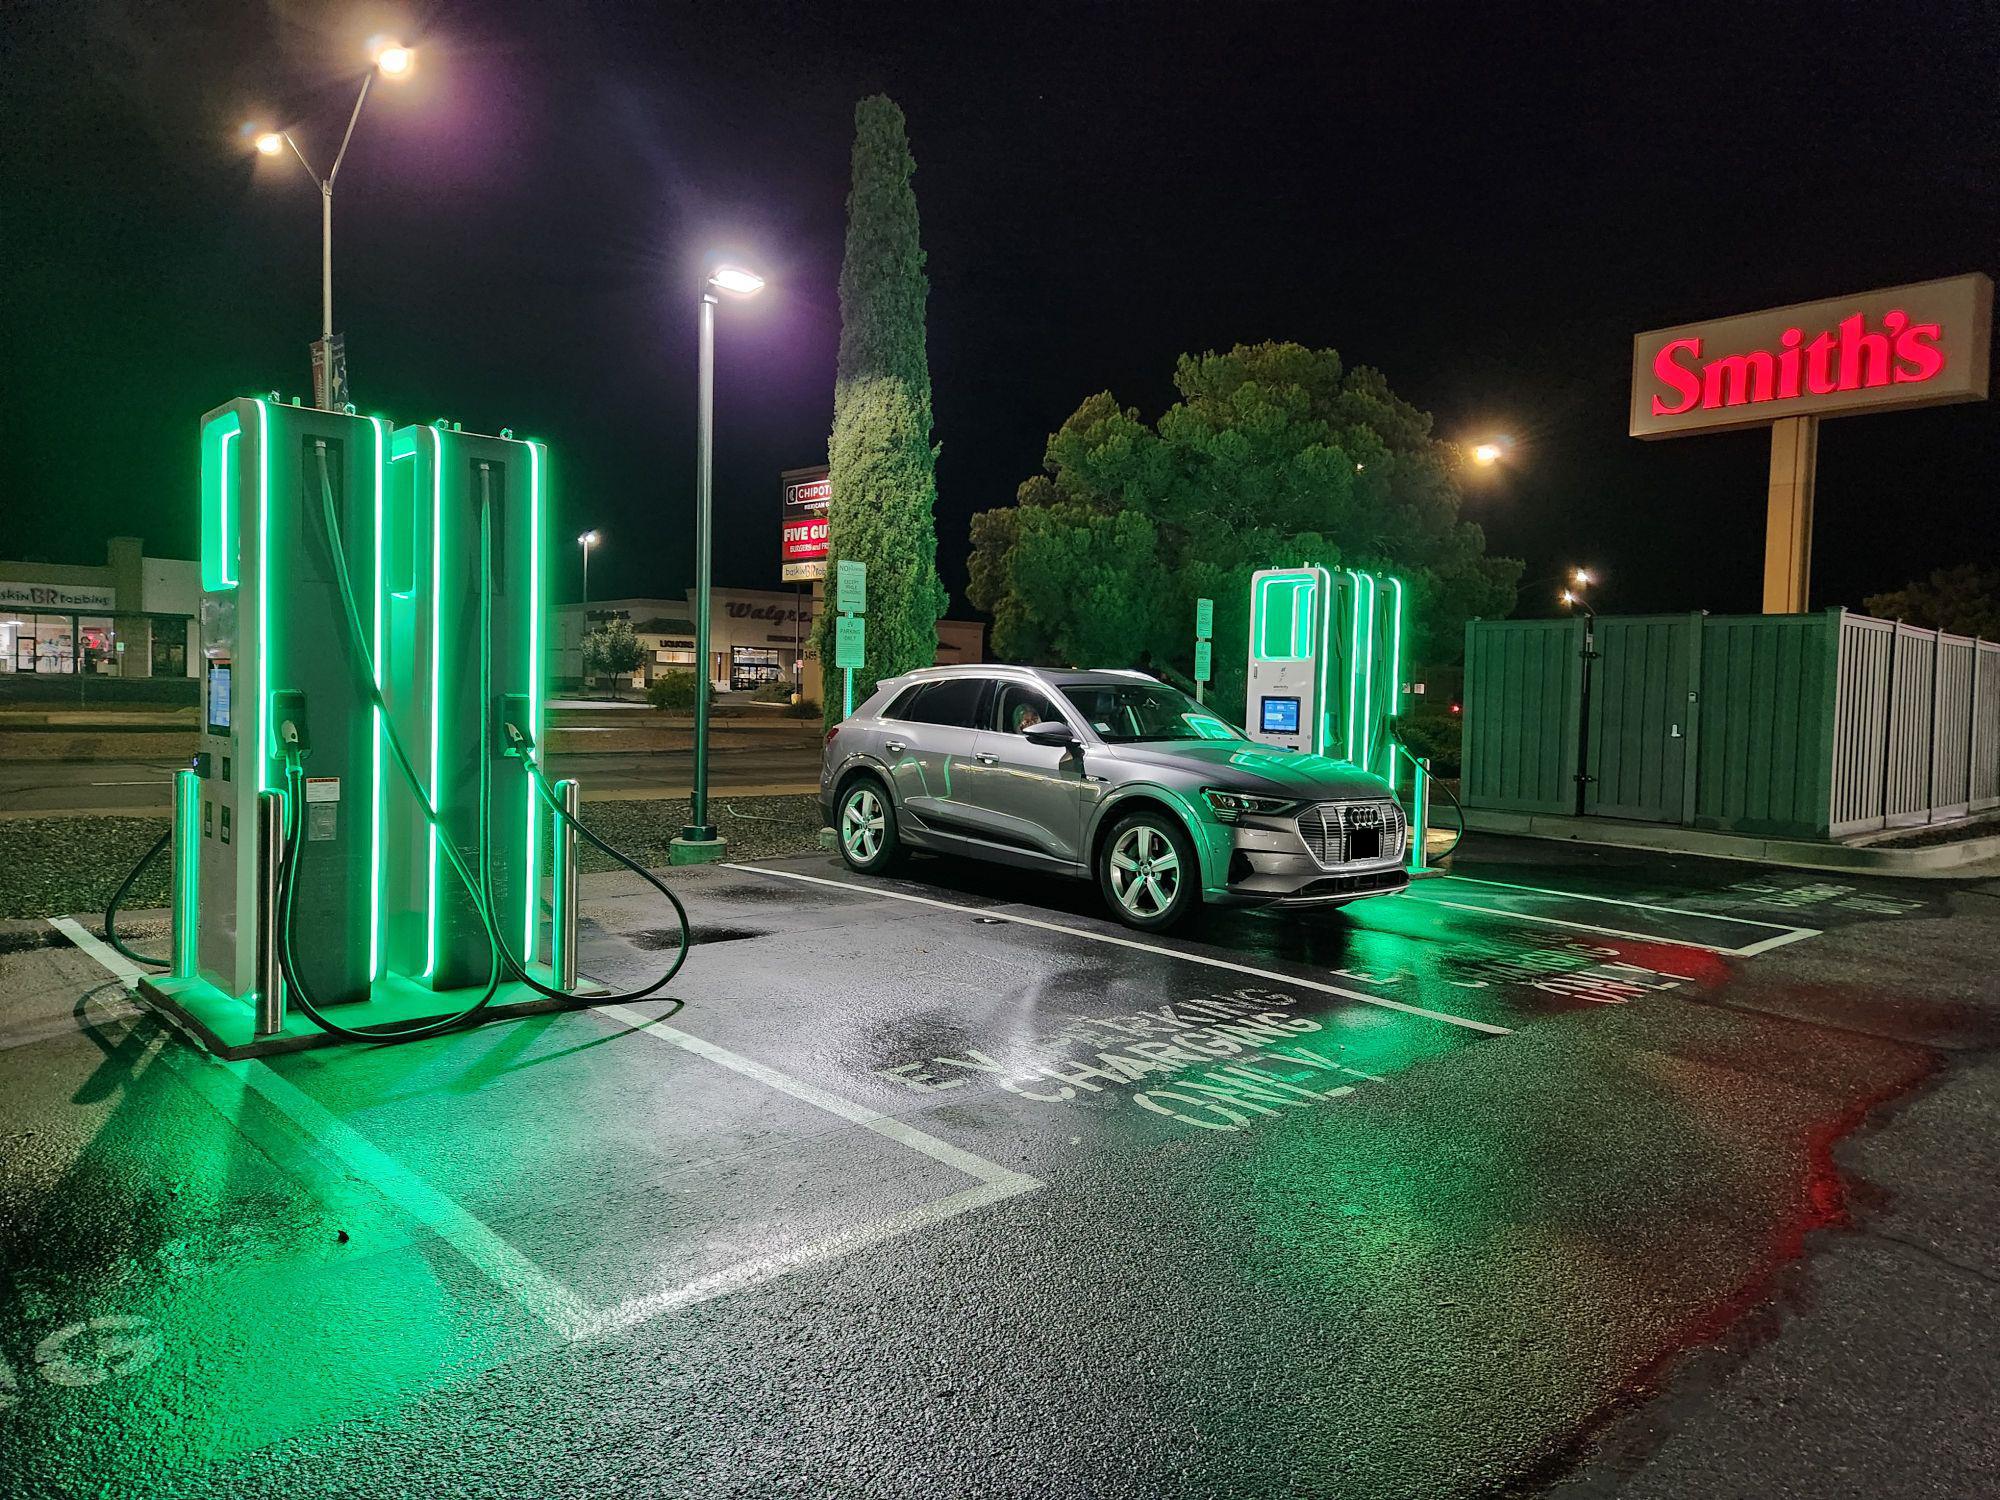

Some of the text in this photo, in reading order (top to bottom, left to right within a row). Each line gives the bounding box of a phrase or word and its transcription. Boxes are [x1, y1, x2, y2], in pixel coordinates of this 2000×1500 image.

[1651, 310, 1945, 416] Smith's
[784, 526, 808, 542] FIVE
[660, 640, 695, 649] LIQUORS
[1531, 961, 1695, 1003] ONLY
[876, 1048, 1005, 1094] EV
[1000, 1012, 1324, 1104] CHARGING
[1132, 1046, 1386, 1131] ONLY
